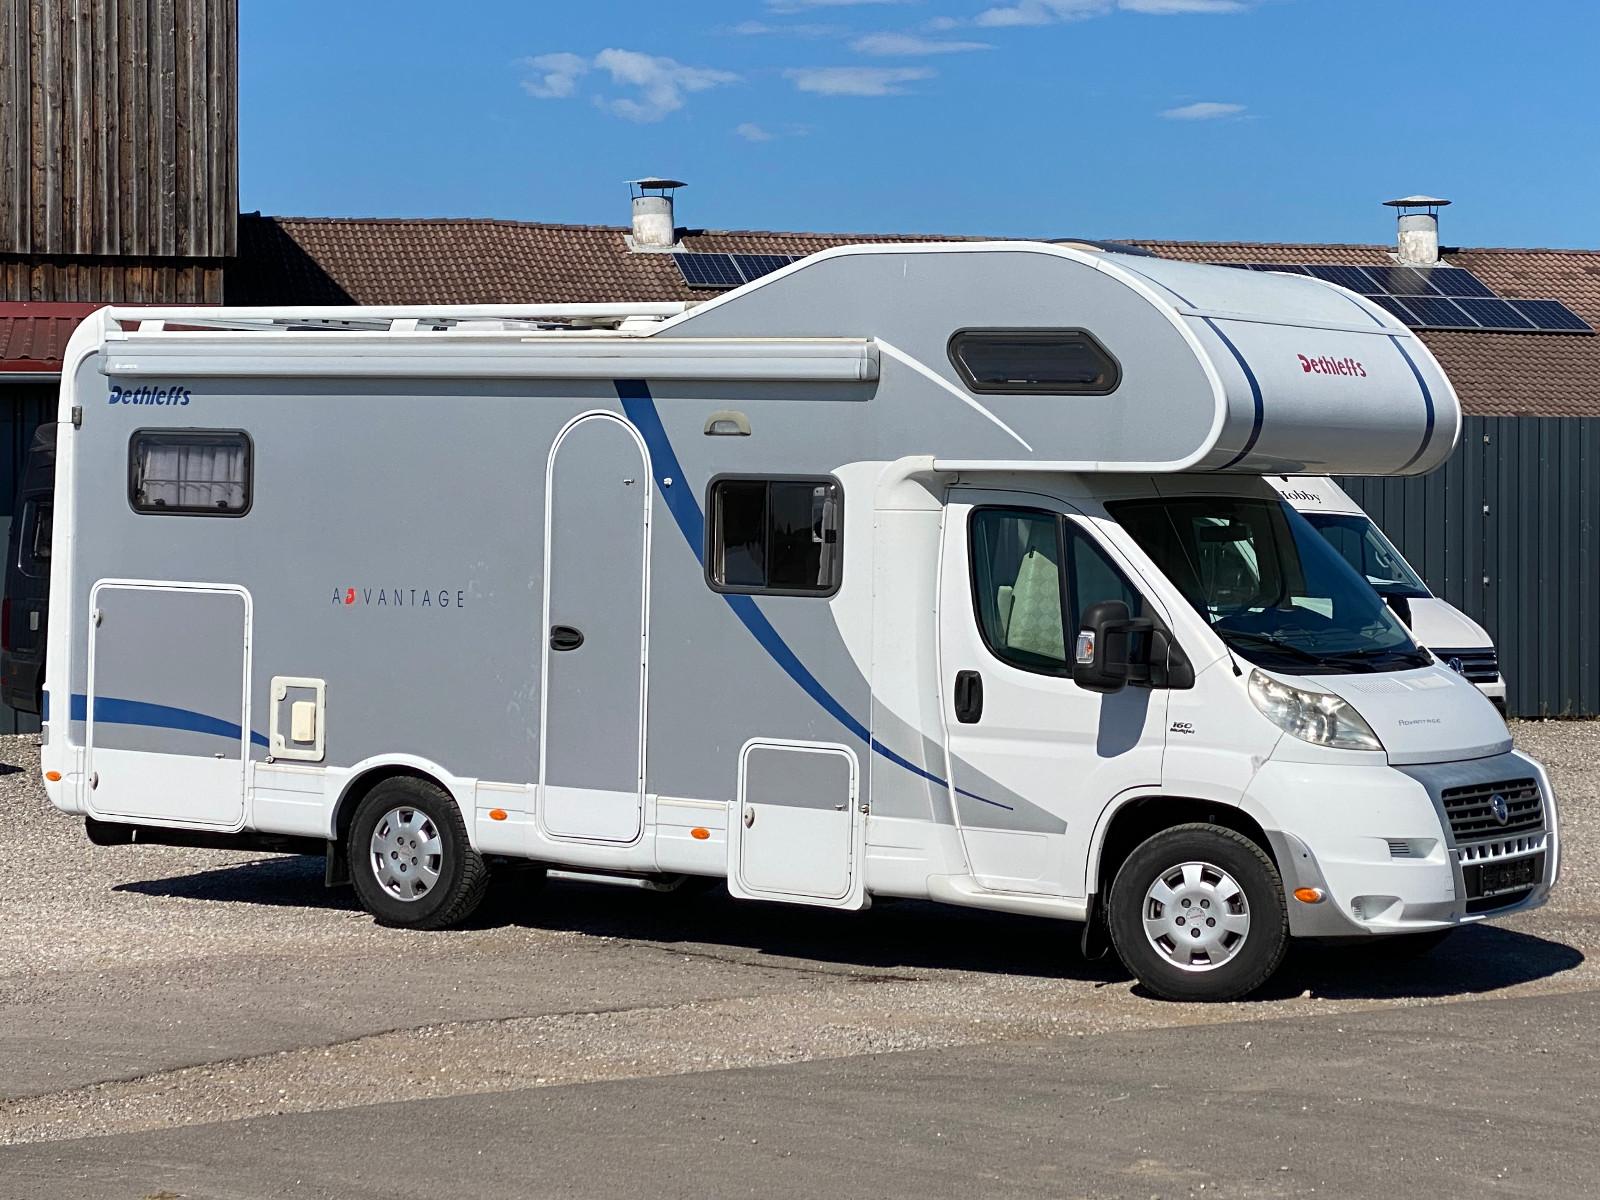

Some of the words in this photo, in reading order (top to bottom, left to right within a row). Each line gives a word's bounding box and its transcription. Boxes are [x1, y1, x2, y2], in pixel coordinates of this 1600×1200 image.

[1297, 353, 1367, 377] Dethleffs
[109, 386, 191, 405] Dethleffs
[331, 587, 464, 608] ADVANTAGE
[1172, 721, 1193, 729] 160
